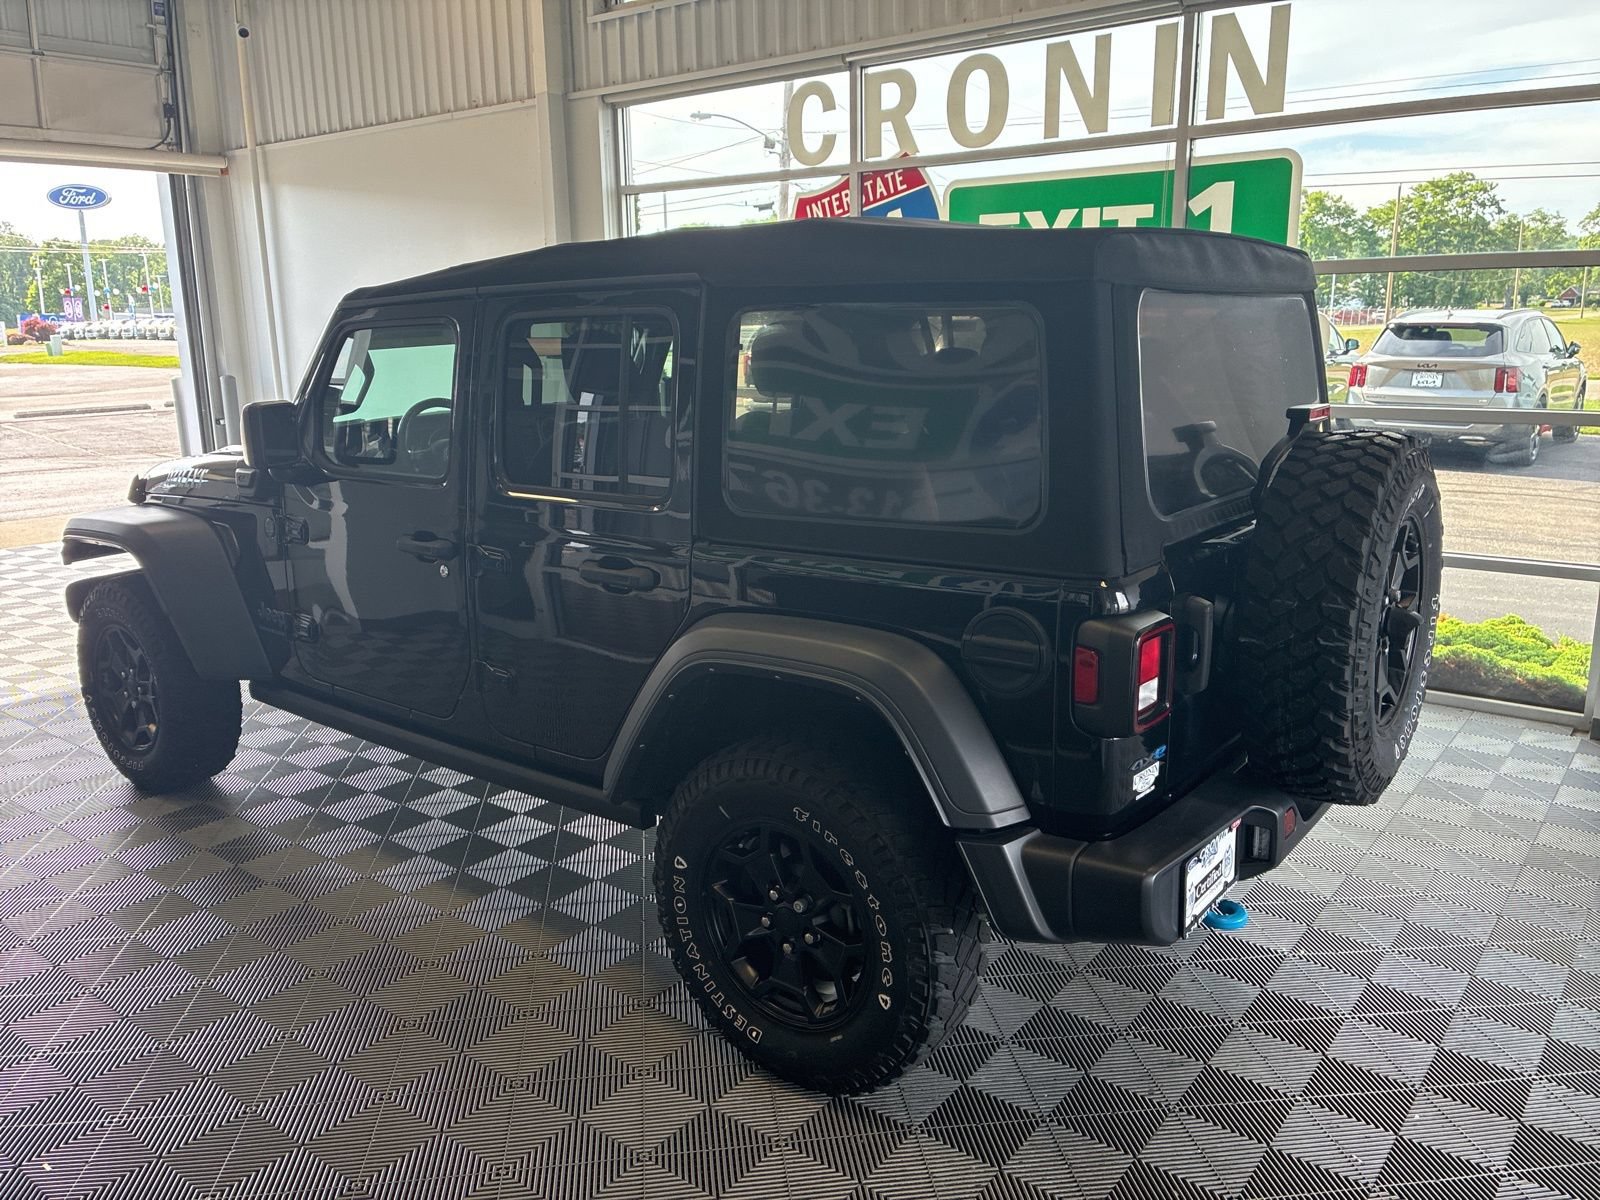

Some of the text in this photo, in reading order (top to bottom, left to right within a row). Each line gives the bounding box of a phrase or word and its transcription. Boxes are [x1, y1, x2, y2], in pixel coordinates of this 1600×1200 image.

[787, 3, 1292, 166] CRONIN
[59, 188, 97, 205] Ford
[806, 169, 908, 217] INTERTATE
[1196, 864, 1222, 898] Certified
[673, 875, 763, 1043] DESTINATION
